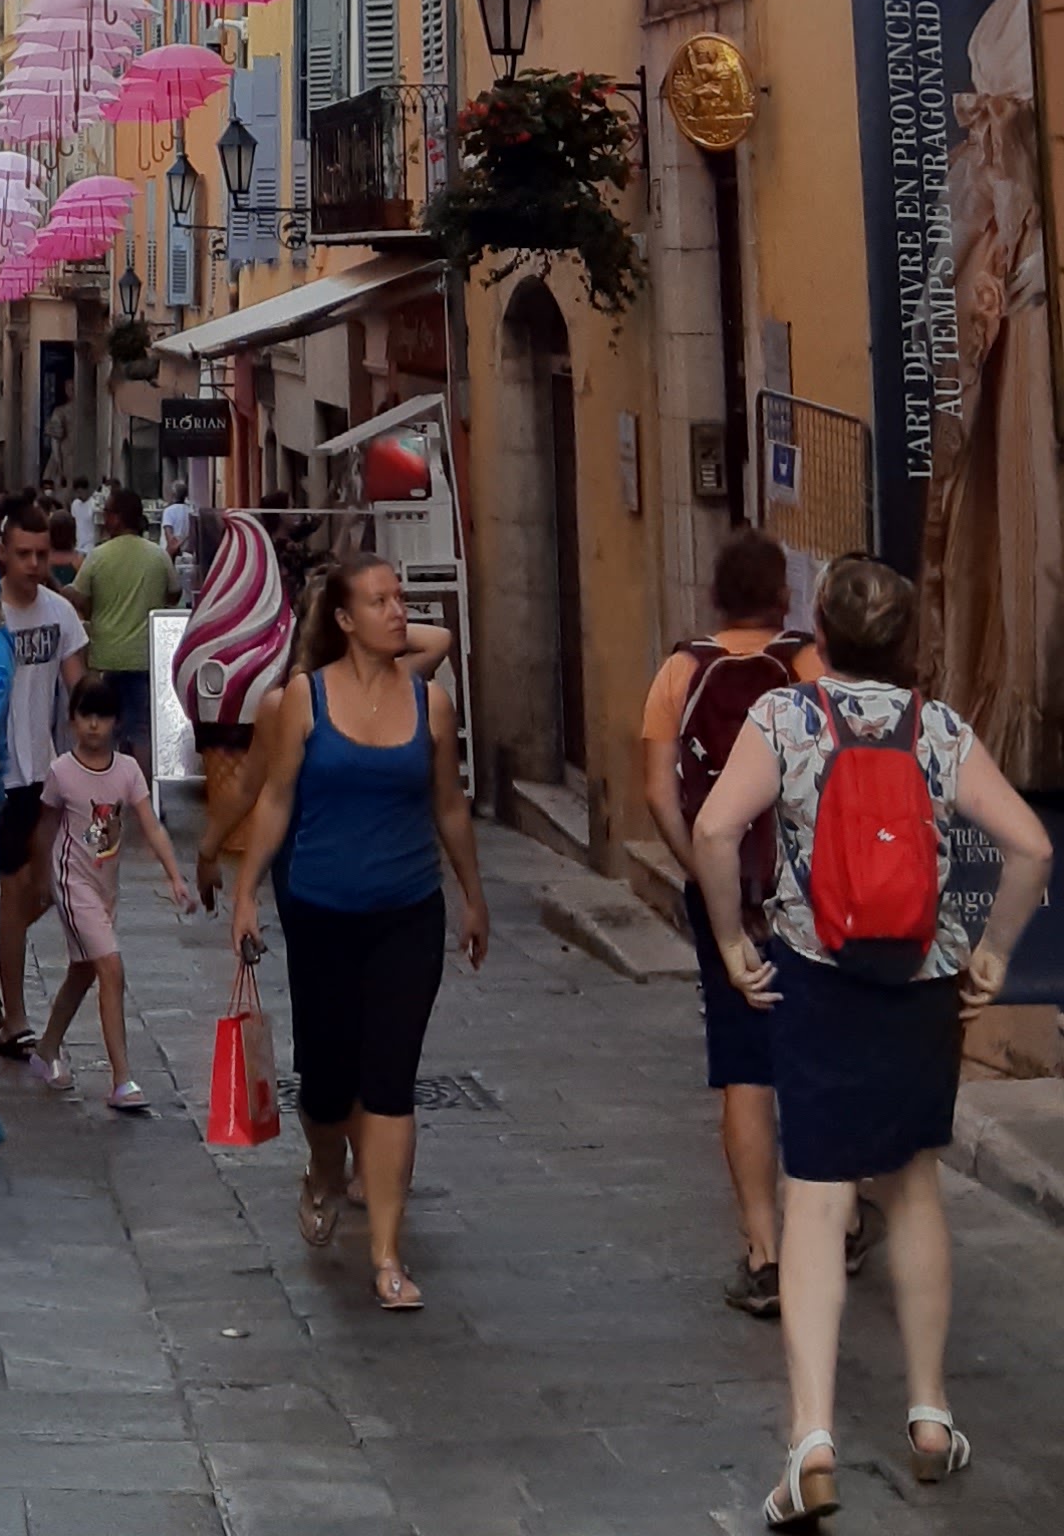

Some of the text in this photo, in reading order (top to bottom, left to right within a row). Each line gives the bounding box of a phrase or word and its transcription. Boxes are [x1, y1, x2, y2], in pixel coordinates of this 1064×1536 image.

[884, 0, 933, 481] L'ART DE VIVRE EN PROVENCE
[915, 0, 964, 421] AU TEMPS DE FRAGONARD
[165, 416, 226, 430] FLORIAN
